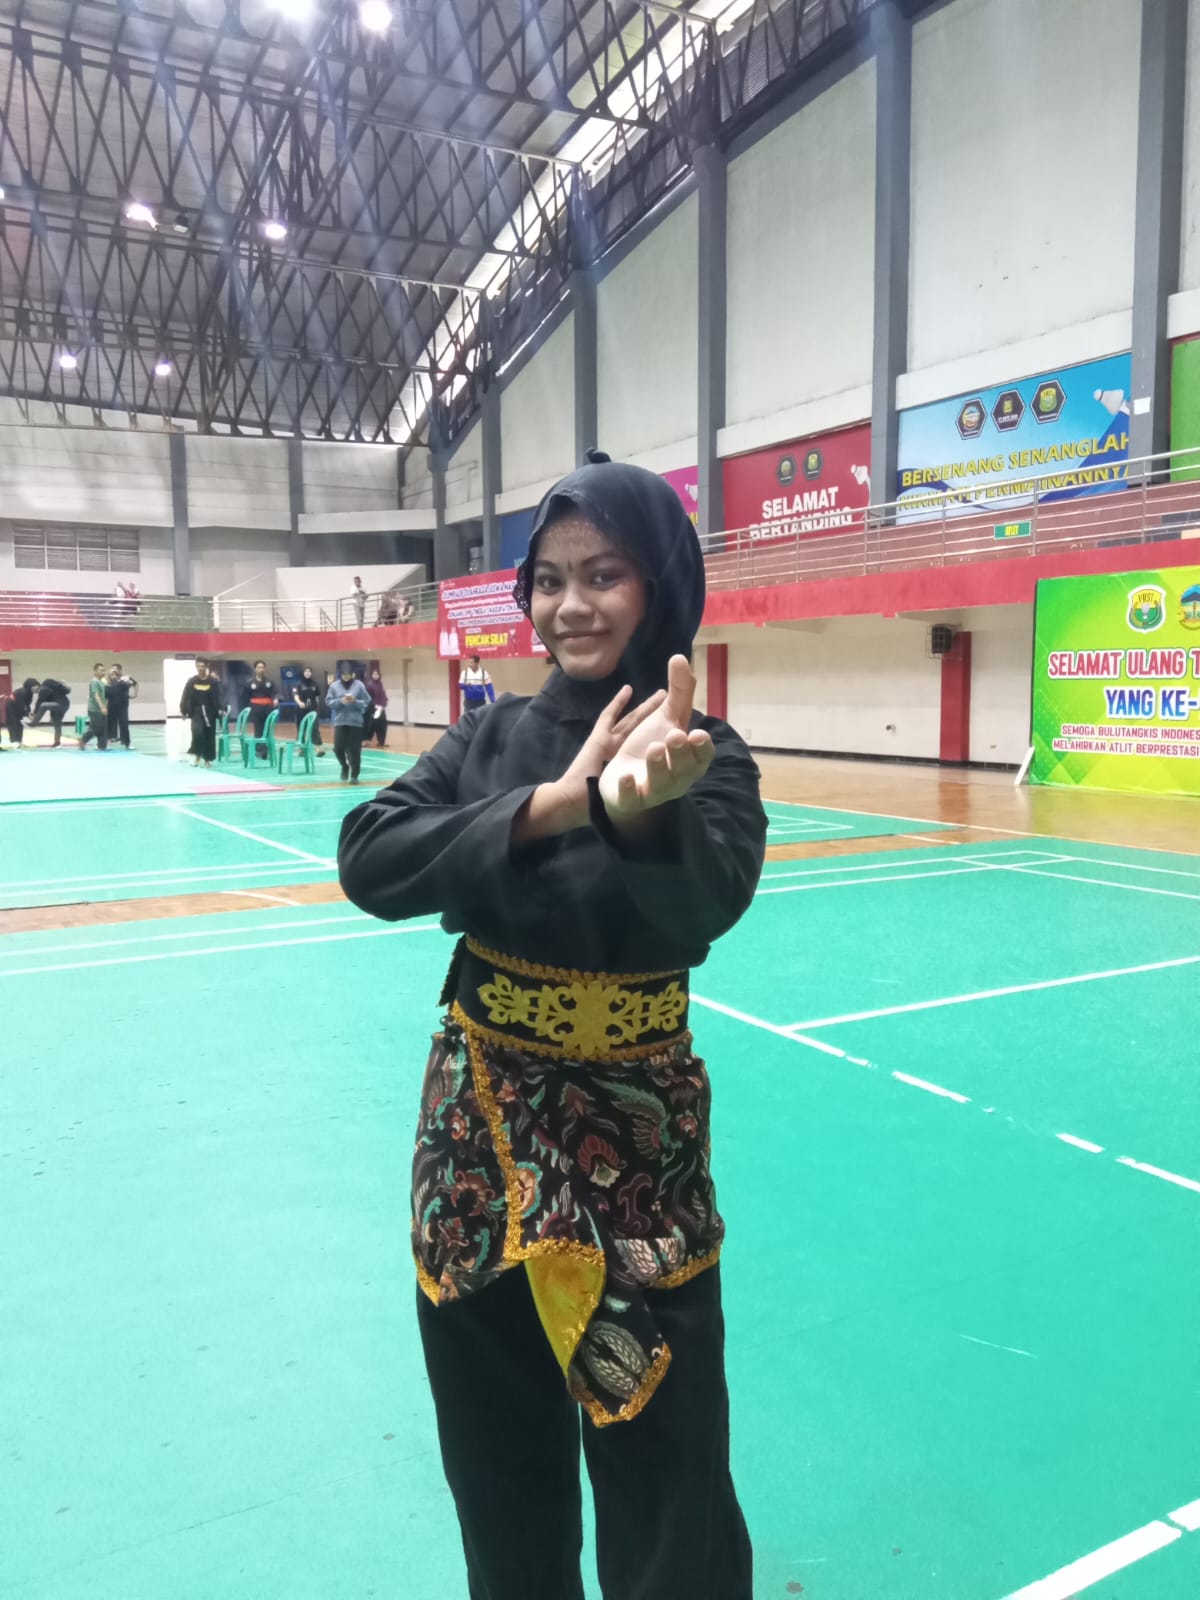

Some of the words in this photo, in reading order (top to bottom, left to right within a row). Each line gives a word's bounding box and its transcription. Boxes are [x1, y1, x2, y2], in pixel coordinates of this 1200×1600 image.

[902, 454, 1004, 487] BERSENANG
[1008, 431, 1129, 469] SENANGLAH
[762, 486, 839, 519] SELAMAT
[1048, 651, 1122, 677] SELAMAT
[1127, 650, 1185, 677] ULANG
[1105, 688, 1154, 717] YANG
[1062, 725, 1095, 736] SEMOGA
[1098, 726, 1158, 739] BULUTANGKIS
[1053, 739, 1106, 751] MELAHIRKAN
[1109, 742, 1133, 753] ATLIT
[1136, 743, 1200, 757] BERPRESTASI
